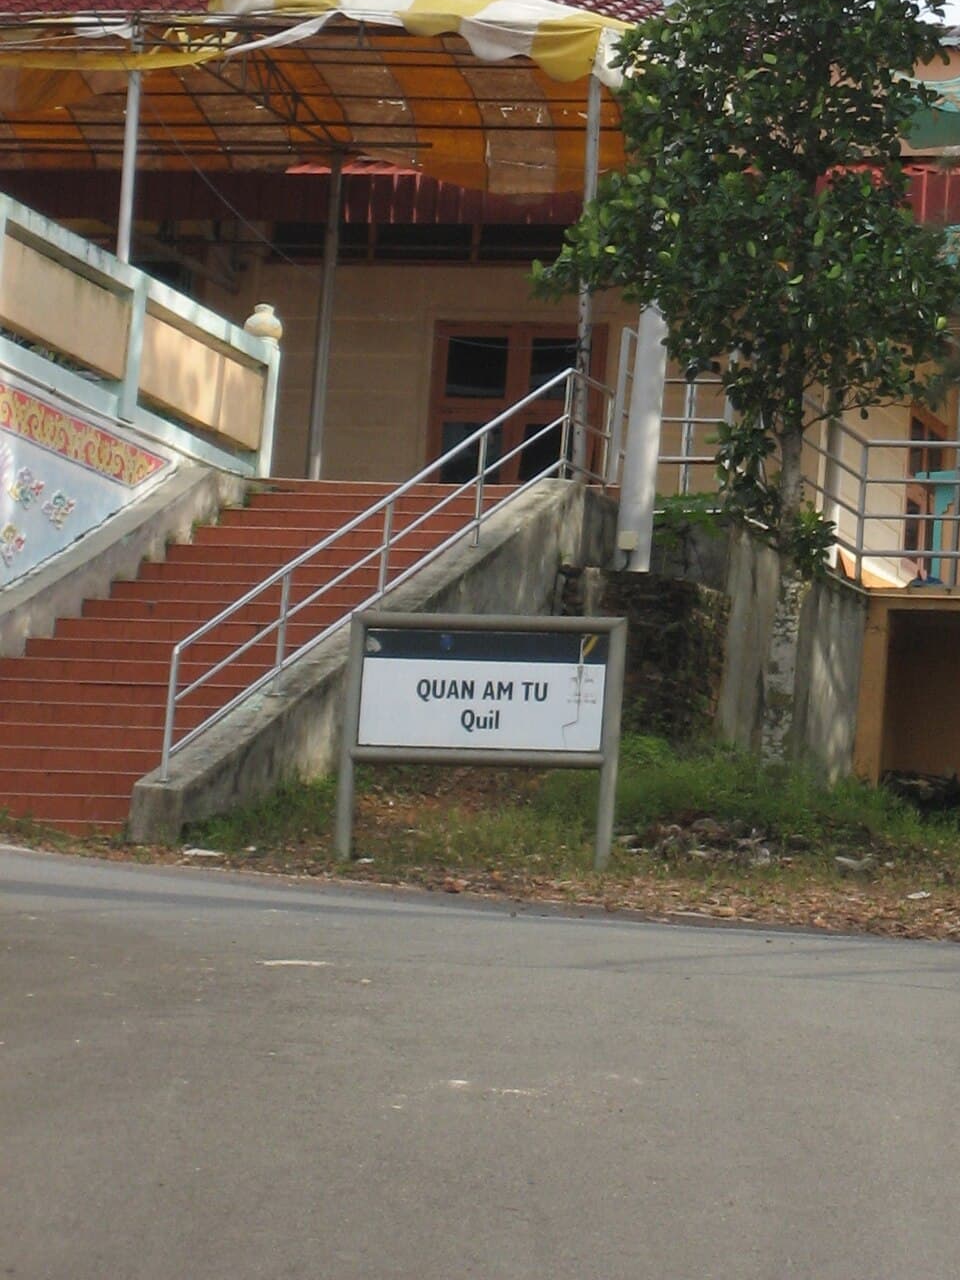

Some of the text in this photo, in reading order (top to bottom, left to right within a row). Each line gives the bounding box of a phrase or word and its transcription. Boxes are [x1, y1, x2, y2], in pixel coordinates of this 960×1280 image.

[416, 678, 549, 702] QUAN AM TU
